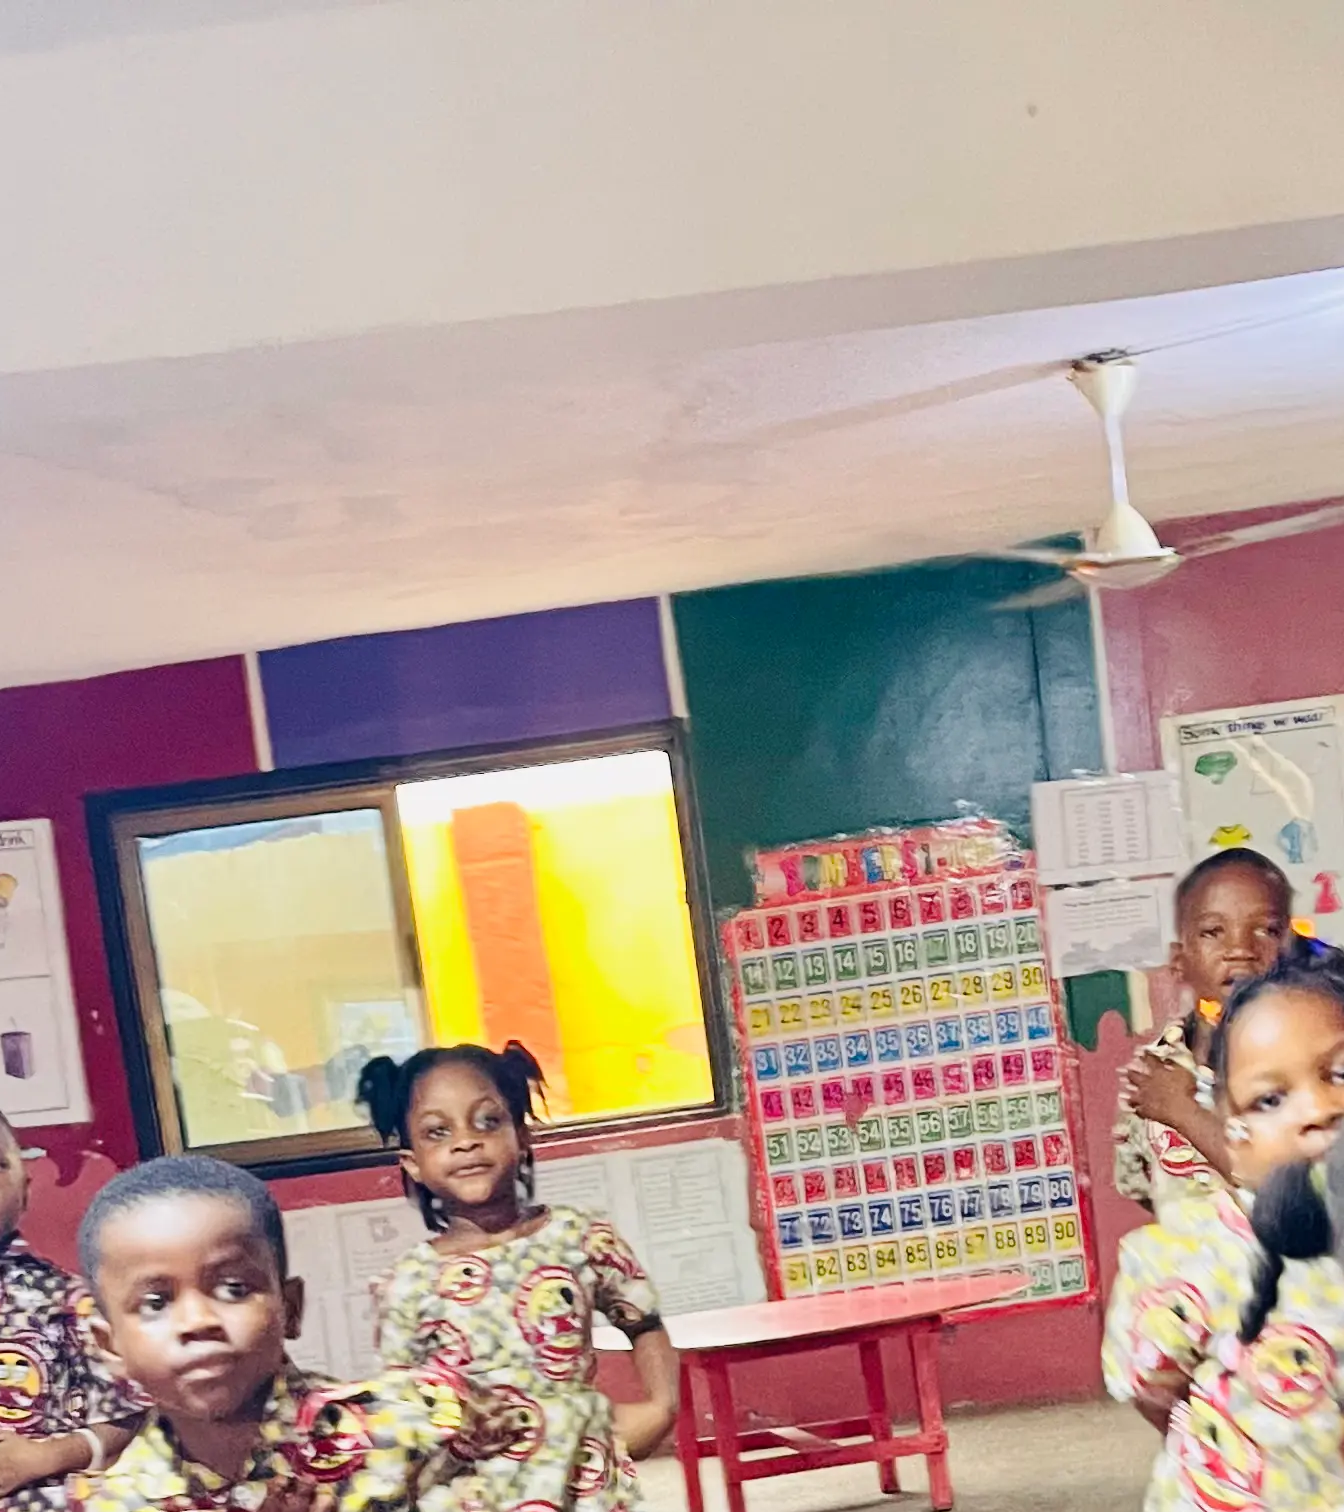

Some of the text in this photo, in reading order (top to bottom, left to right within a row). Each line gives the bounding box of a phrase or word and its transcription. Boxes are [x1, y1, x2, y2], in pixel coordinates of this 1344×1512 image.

[770, 917, 785, 938] 2
[802, 913, 814, 933] 3
[832, 908, 845, 928] 4
[862, 903, 876, 924] 5
[893, 899, 906, 920] 6
[774, 960, 794, 981] 12
[805, 955, 824, 977] 13
[835, 951, 854, 972] 14
[869, 949, 886, 970] 15
[896, 941, 915, 962] 16
[958, 933, 975, 953] 18
[987, 928, 1006, 948] 19
[1017, 924, 1037, 943] 20
[779, 1003, 802, 1024] 22
[870, 989, 892, 1010] 25
[901, 984, 922, 1005] 26
[931, 980, 952, 1001] 27
[962, 975, 983, 995] 28
[992, 971, 1013, 991] 29
[1022, 967, 1043, 986] 30
[757, 1050, 778, 1070] 31
[786, 1045, 809, 1066] 32
[817, 1041, 837, 1061] 33
[847, 1037, 868, 1058] 34
[877, 1032, 899, 1053] 35
[907, 1026, 928, 1047] 36
[937, 1022, 957, 1043] 37
[997, 1013, 1019, 1034] 39
[768, 1138, 789, 1158] 51
[798, 1132, 819, 1152] 52
[828, 1127, 850, 1148] 53
[859, 1122, 880, 1144] 54
[889, 1118, 910, 1139] 55
[918, 1114, 941, 1135] 56
[949, 1109, 968, 1130] 57
[839, 1211, 862, 1231] 73
[869, 1207, 892, 1228] 74
[900, 1202, 922, 1222] 75
[930, 1198, 953, 1218] 76
[1020, 1184, 1042, 1204] 79
[1050, 1180, 1072, 1200] 80
[815, 1256, 838, 1277] 82
[847, 1252, 867, 1272] 83
[876, 1248, 896, 1268] 84
[906, 1243, 927, 1263] 85
[935, 1239, 956, 1259] 86
[995, 1229, 1016, 1250] 88
[1025, 1225, 1046, 1245] 89
[1054, 1220, 1076, 1240] 90
